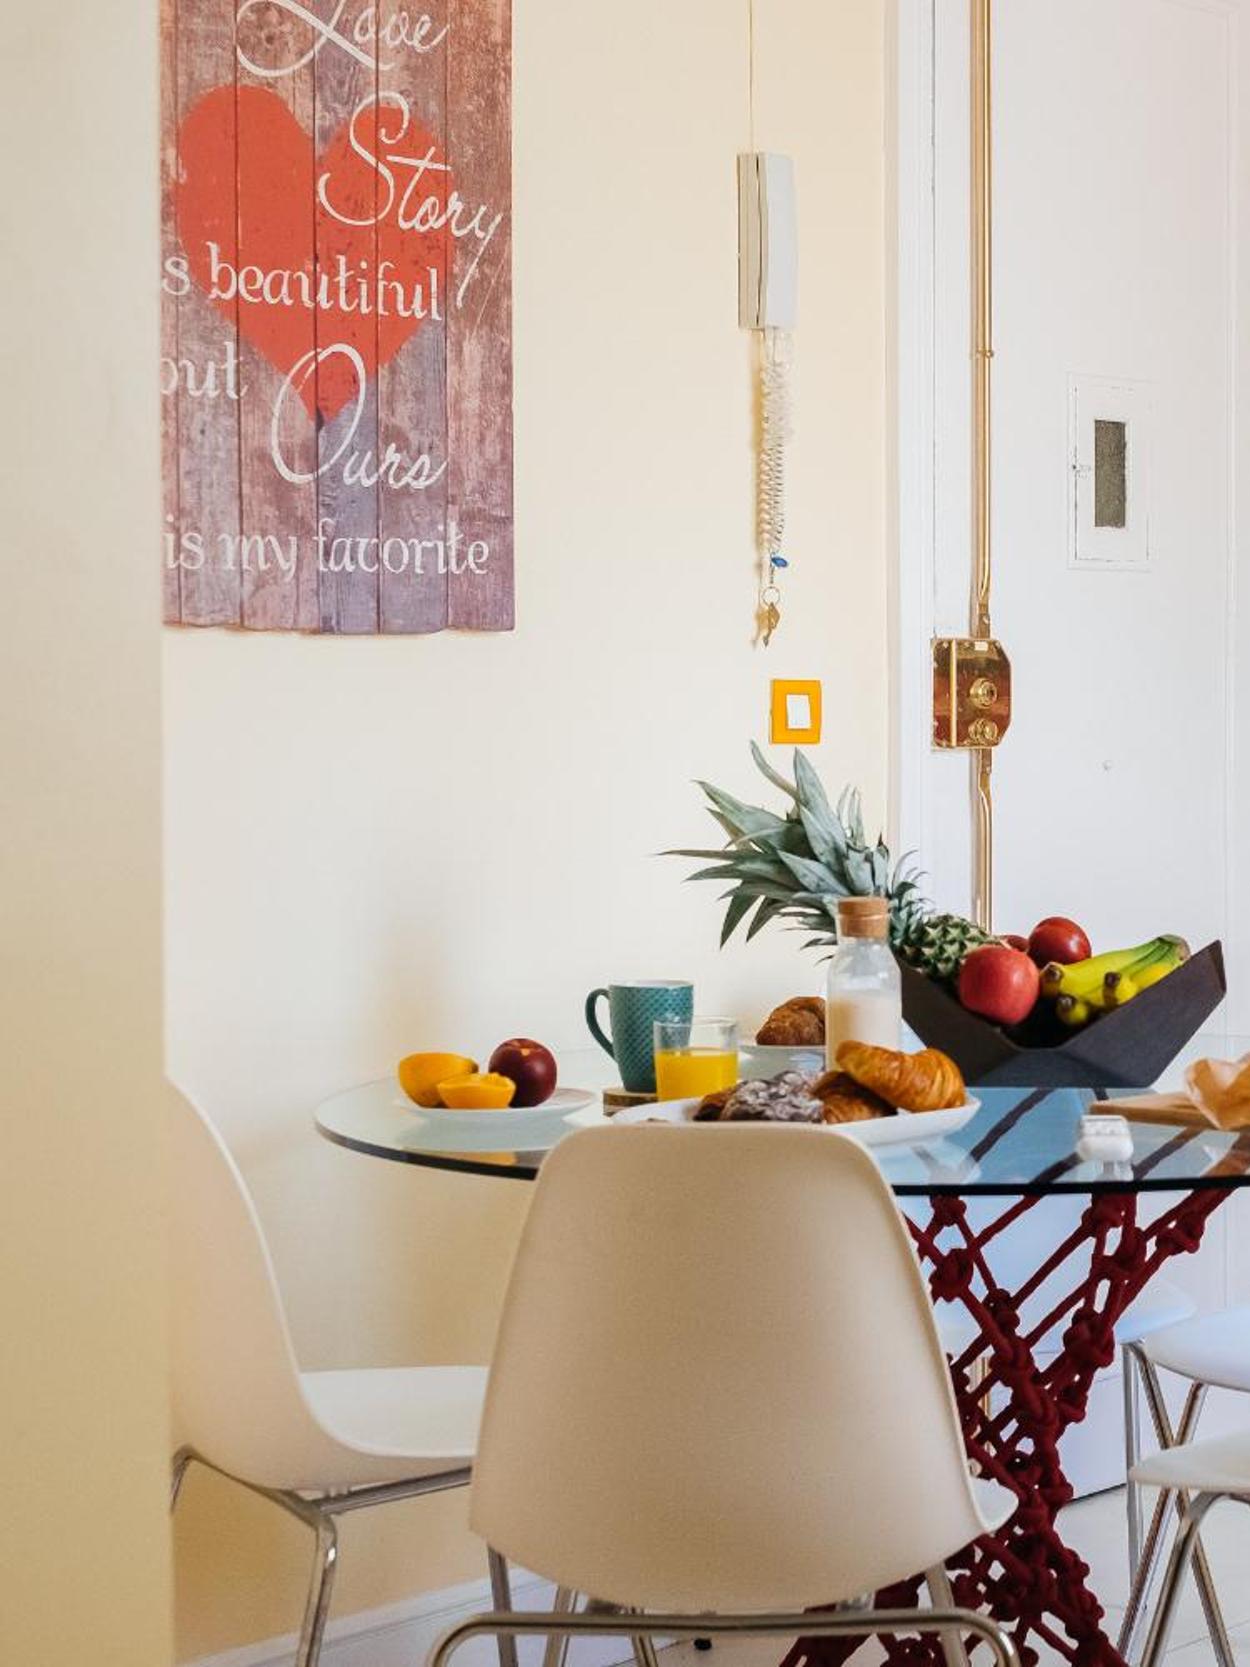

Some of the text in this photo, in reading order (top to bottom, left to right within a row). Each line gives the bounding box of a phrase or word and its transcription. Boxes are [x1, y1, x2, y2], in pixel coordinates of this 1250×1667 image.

[318, 91, 501, 309] Story
[206, 241, 442, 321] beautiful
[271, 343, 446, 489] Ours
[163, 514, 490, 581] is my favorite
